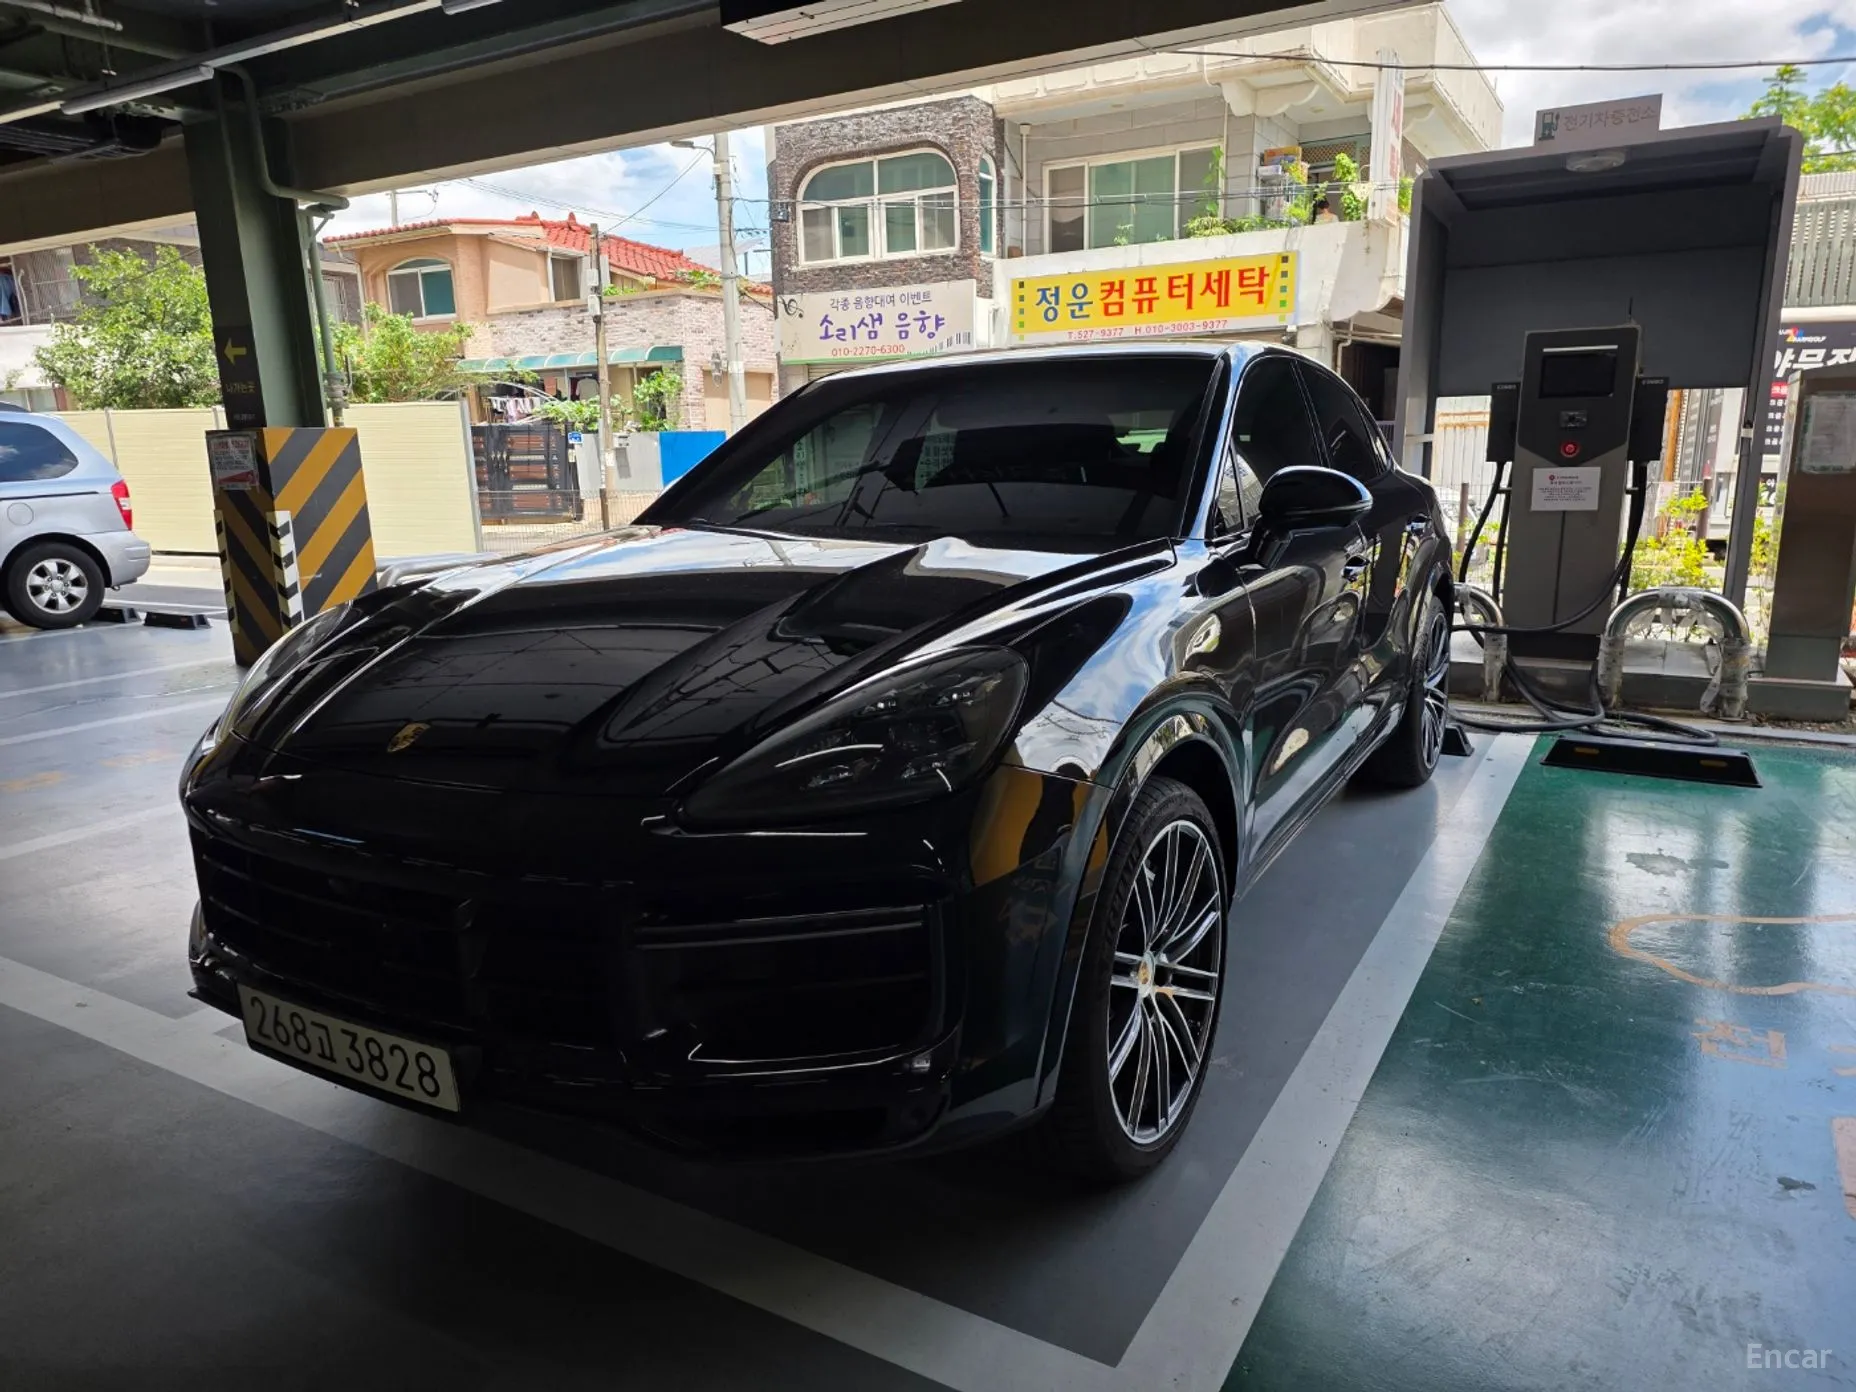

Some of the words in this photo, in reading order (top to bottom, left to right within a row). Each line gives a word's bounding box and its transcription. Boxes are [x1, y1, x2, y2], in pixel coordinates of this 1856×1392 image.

[1563, 105, 1658, 133] 전기차충전소
[830, 296, 850, 311] 각종
[853, 292, 896, 310] 음향대여
[899, 290, 933, 307] 이벤트
[1035, 266, 1270, 323] 정운컴퓨터세탁
[818, 312, 883, 342] 소리샘
[895, 309, 946, 341] 음향
[831, 343, 906, 357] 010-2270-6300
[251, 996, 336, 1064] 268고
[340, 1028, 440, 1098] 3828
